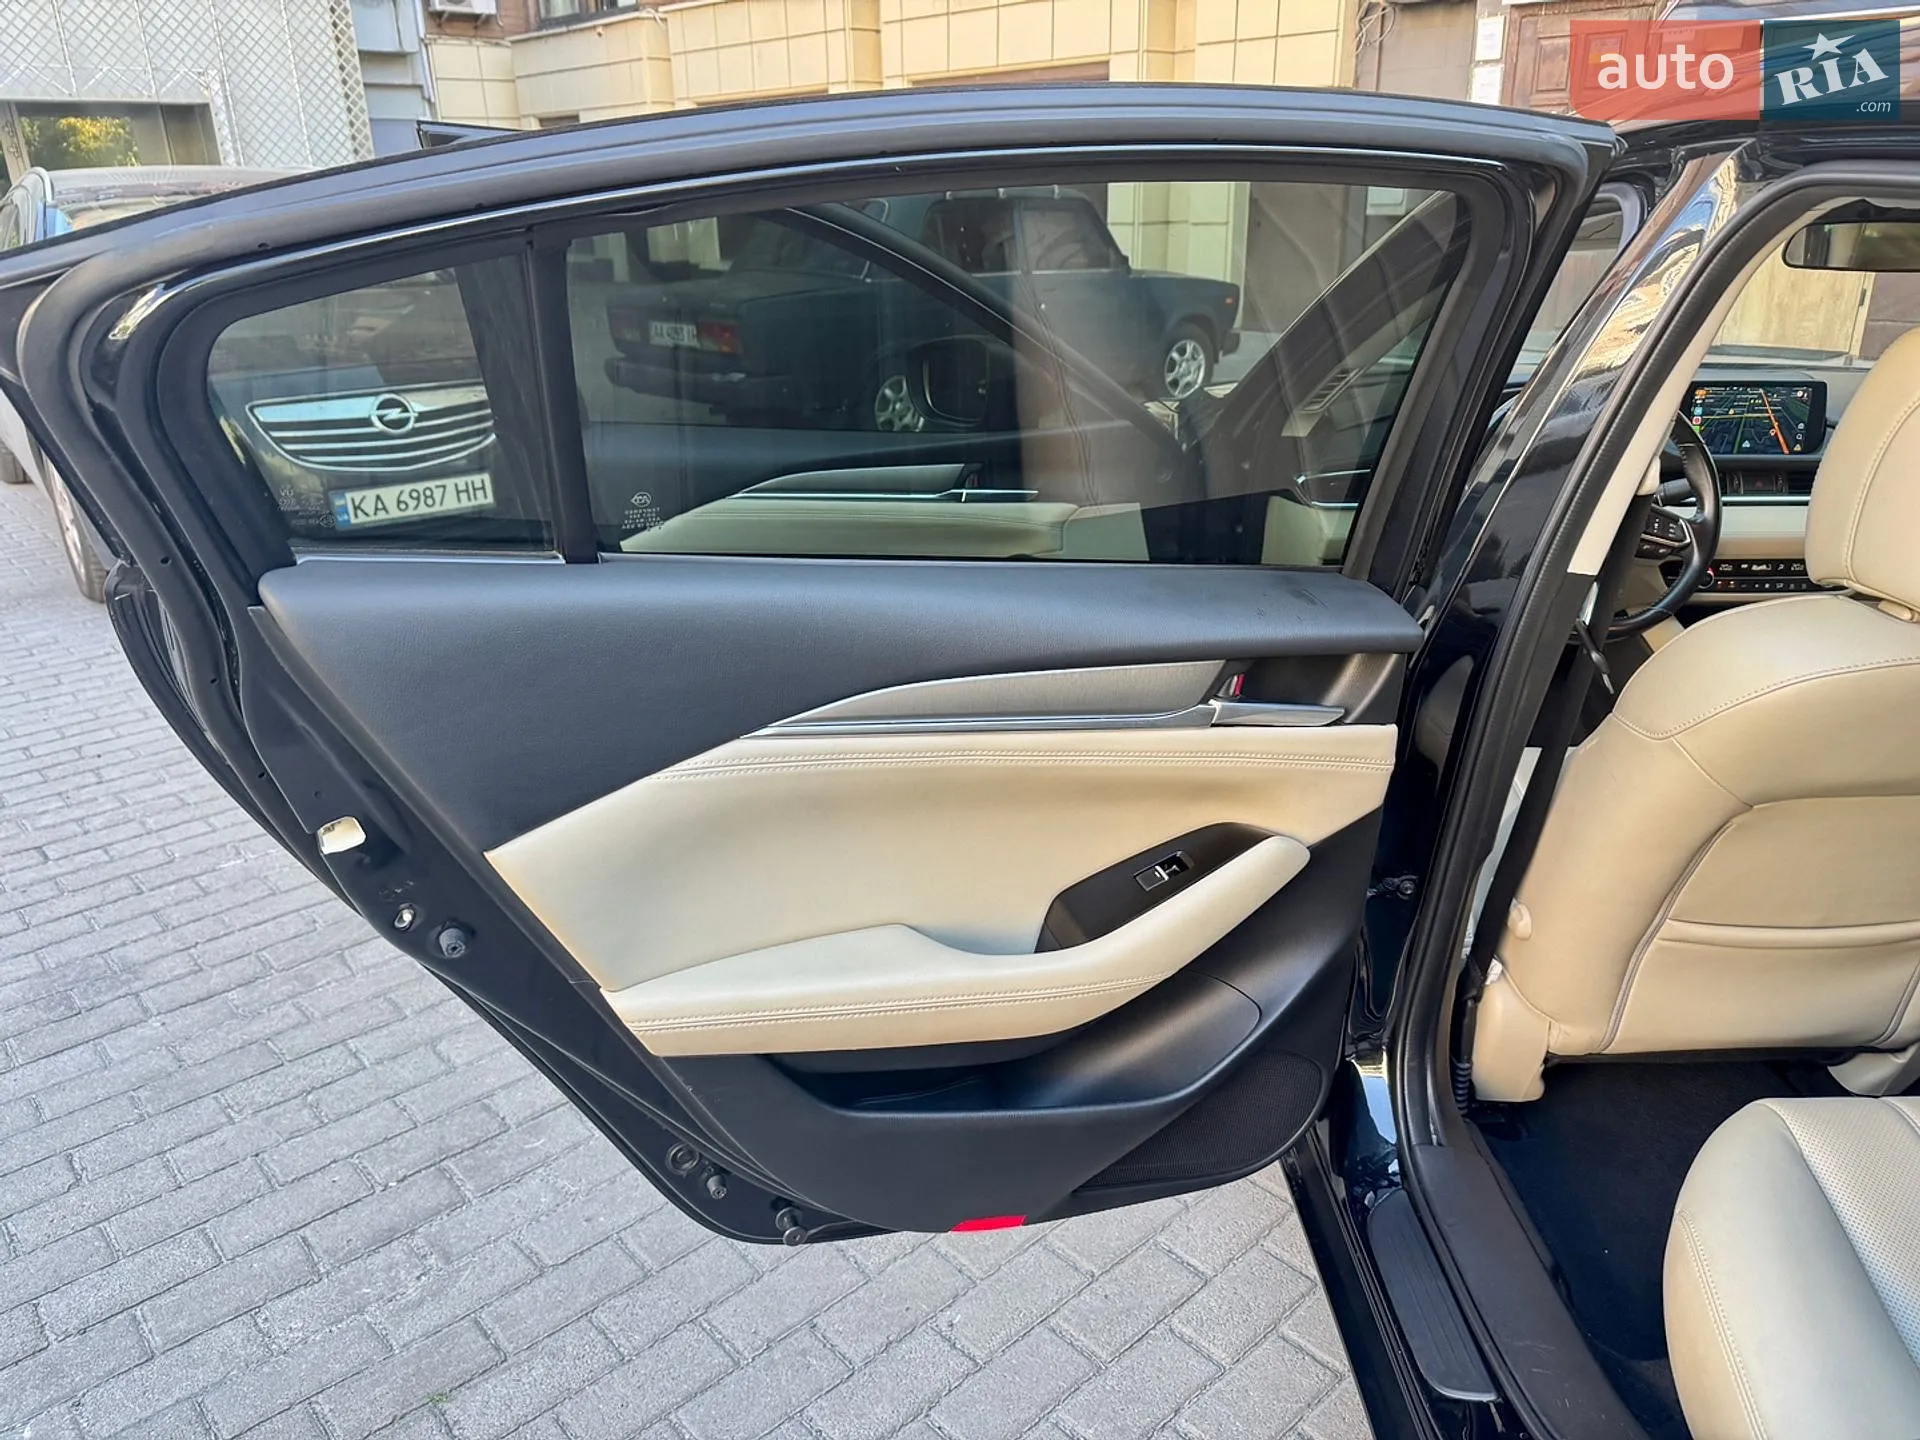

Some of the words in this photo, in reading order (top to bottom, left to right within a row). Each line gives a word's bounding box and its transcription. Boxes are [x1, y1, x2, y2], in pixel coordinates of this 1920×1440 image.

[350, 494, 389, 519] KA
[396, 485, 447, 512] 6987
[454, 478, 488, 504] HH
